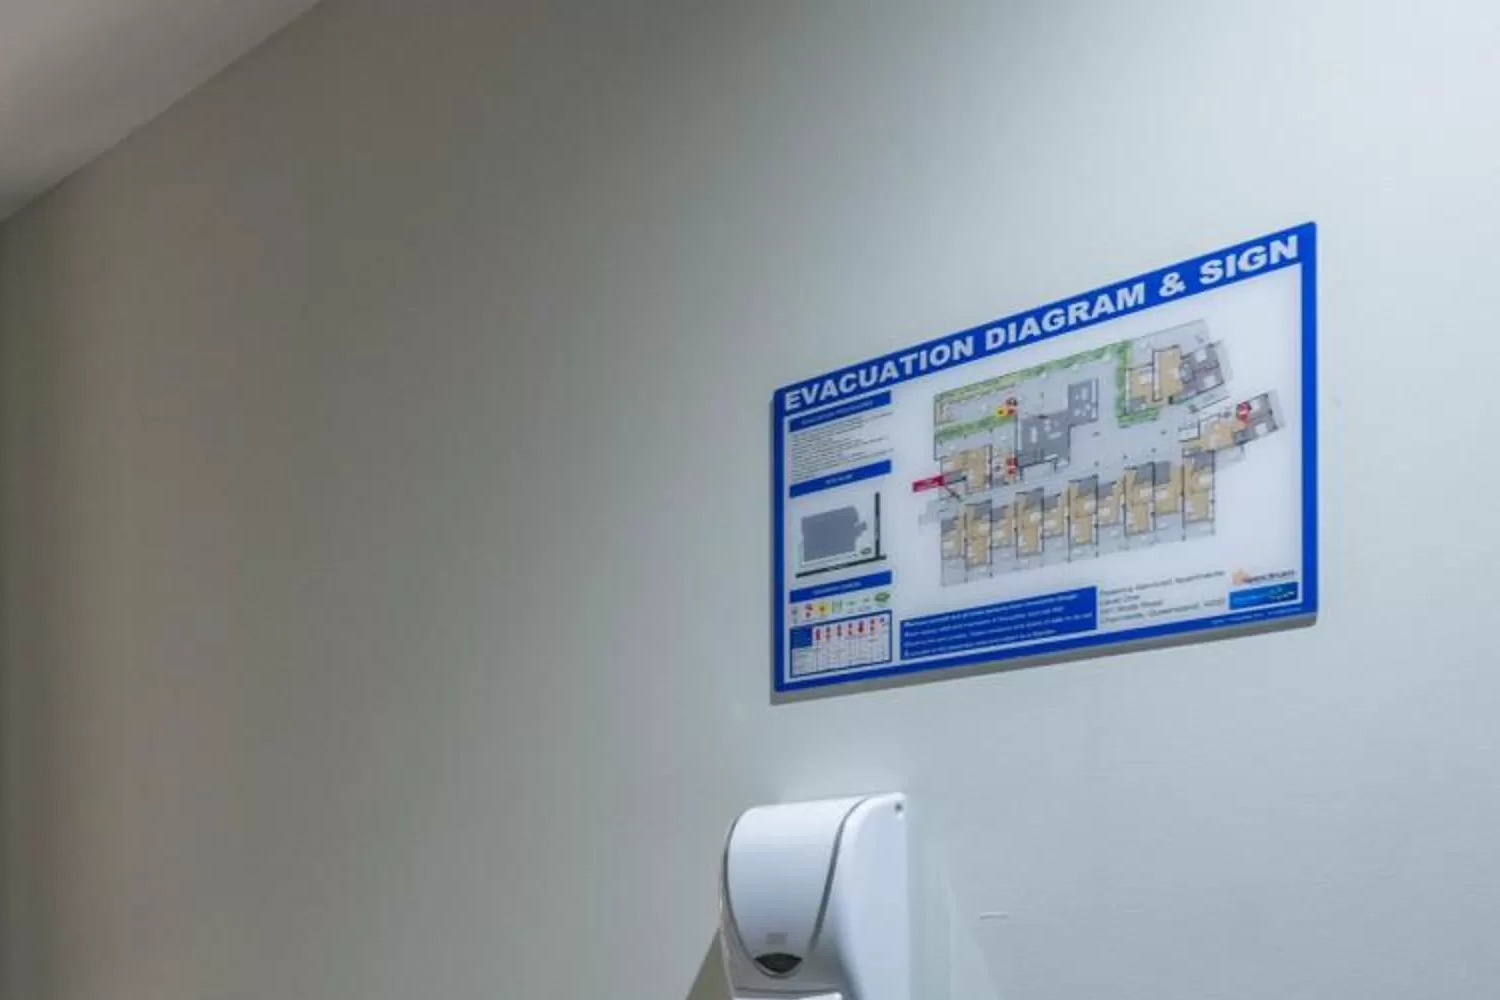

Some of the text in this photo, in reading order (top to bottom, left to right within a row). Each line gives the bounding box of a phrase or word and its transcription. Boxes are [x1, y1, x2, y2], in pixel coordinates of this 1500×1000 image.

[784, 235, 1298, 411] EVACUATION DIAGRAM & SIGN
